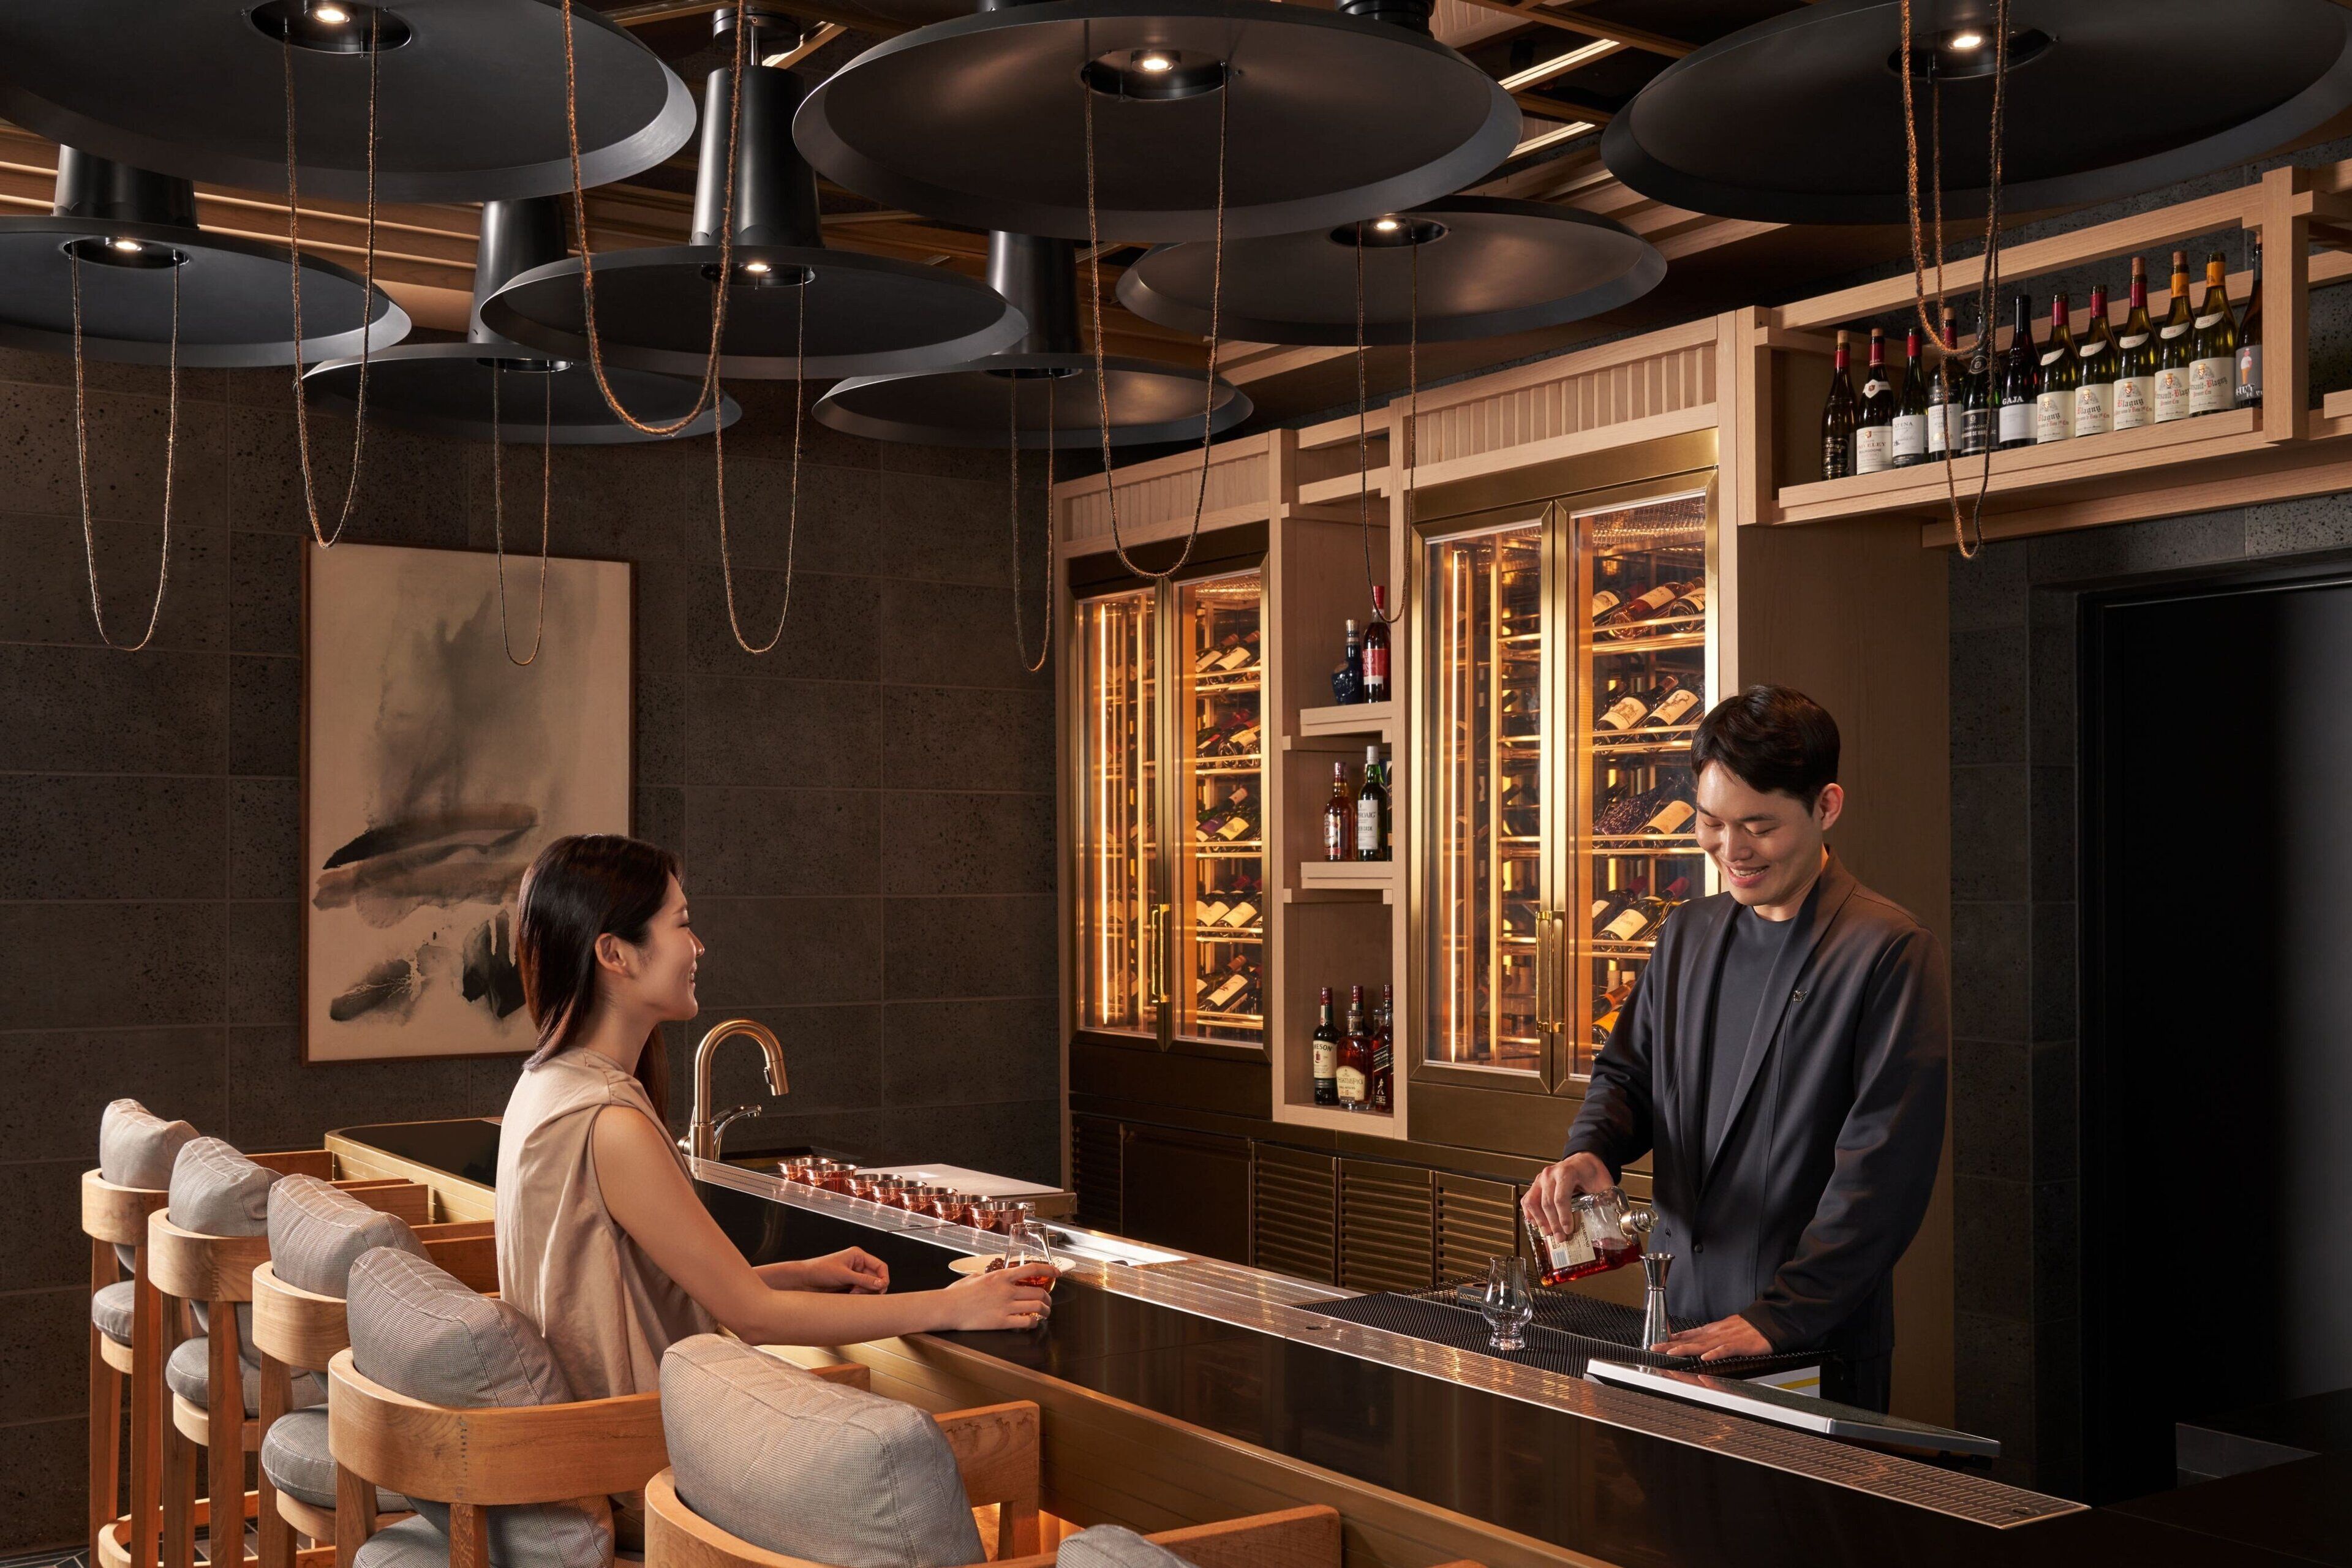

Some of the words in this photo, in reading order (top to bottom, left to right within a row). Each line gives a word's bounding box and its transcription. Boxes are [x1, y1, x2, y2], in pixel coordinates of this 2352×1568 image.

[2002, 396, 2024, 405] GAJA
[2117, 398, 2144, 408] Blagny
[2077, 405, 2101, 415] Blagny
[2038, 412, 2060, 422] Blagny
[1580, 1222, 1590, 1248] DISARONNO
